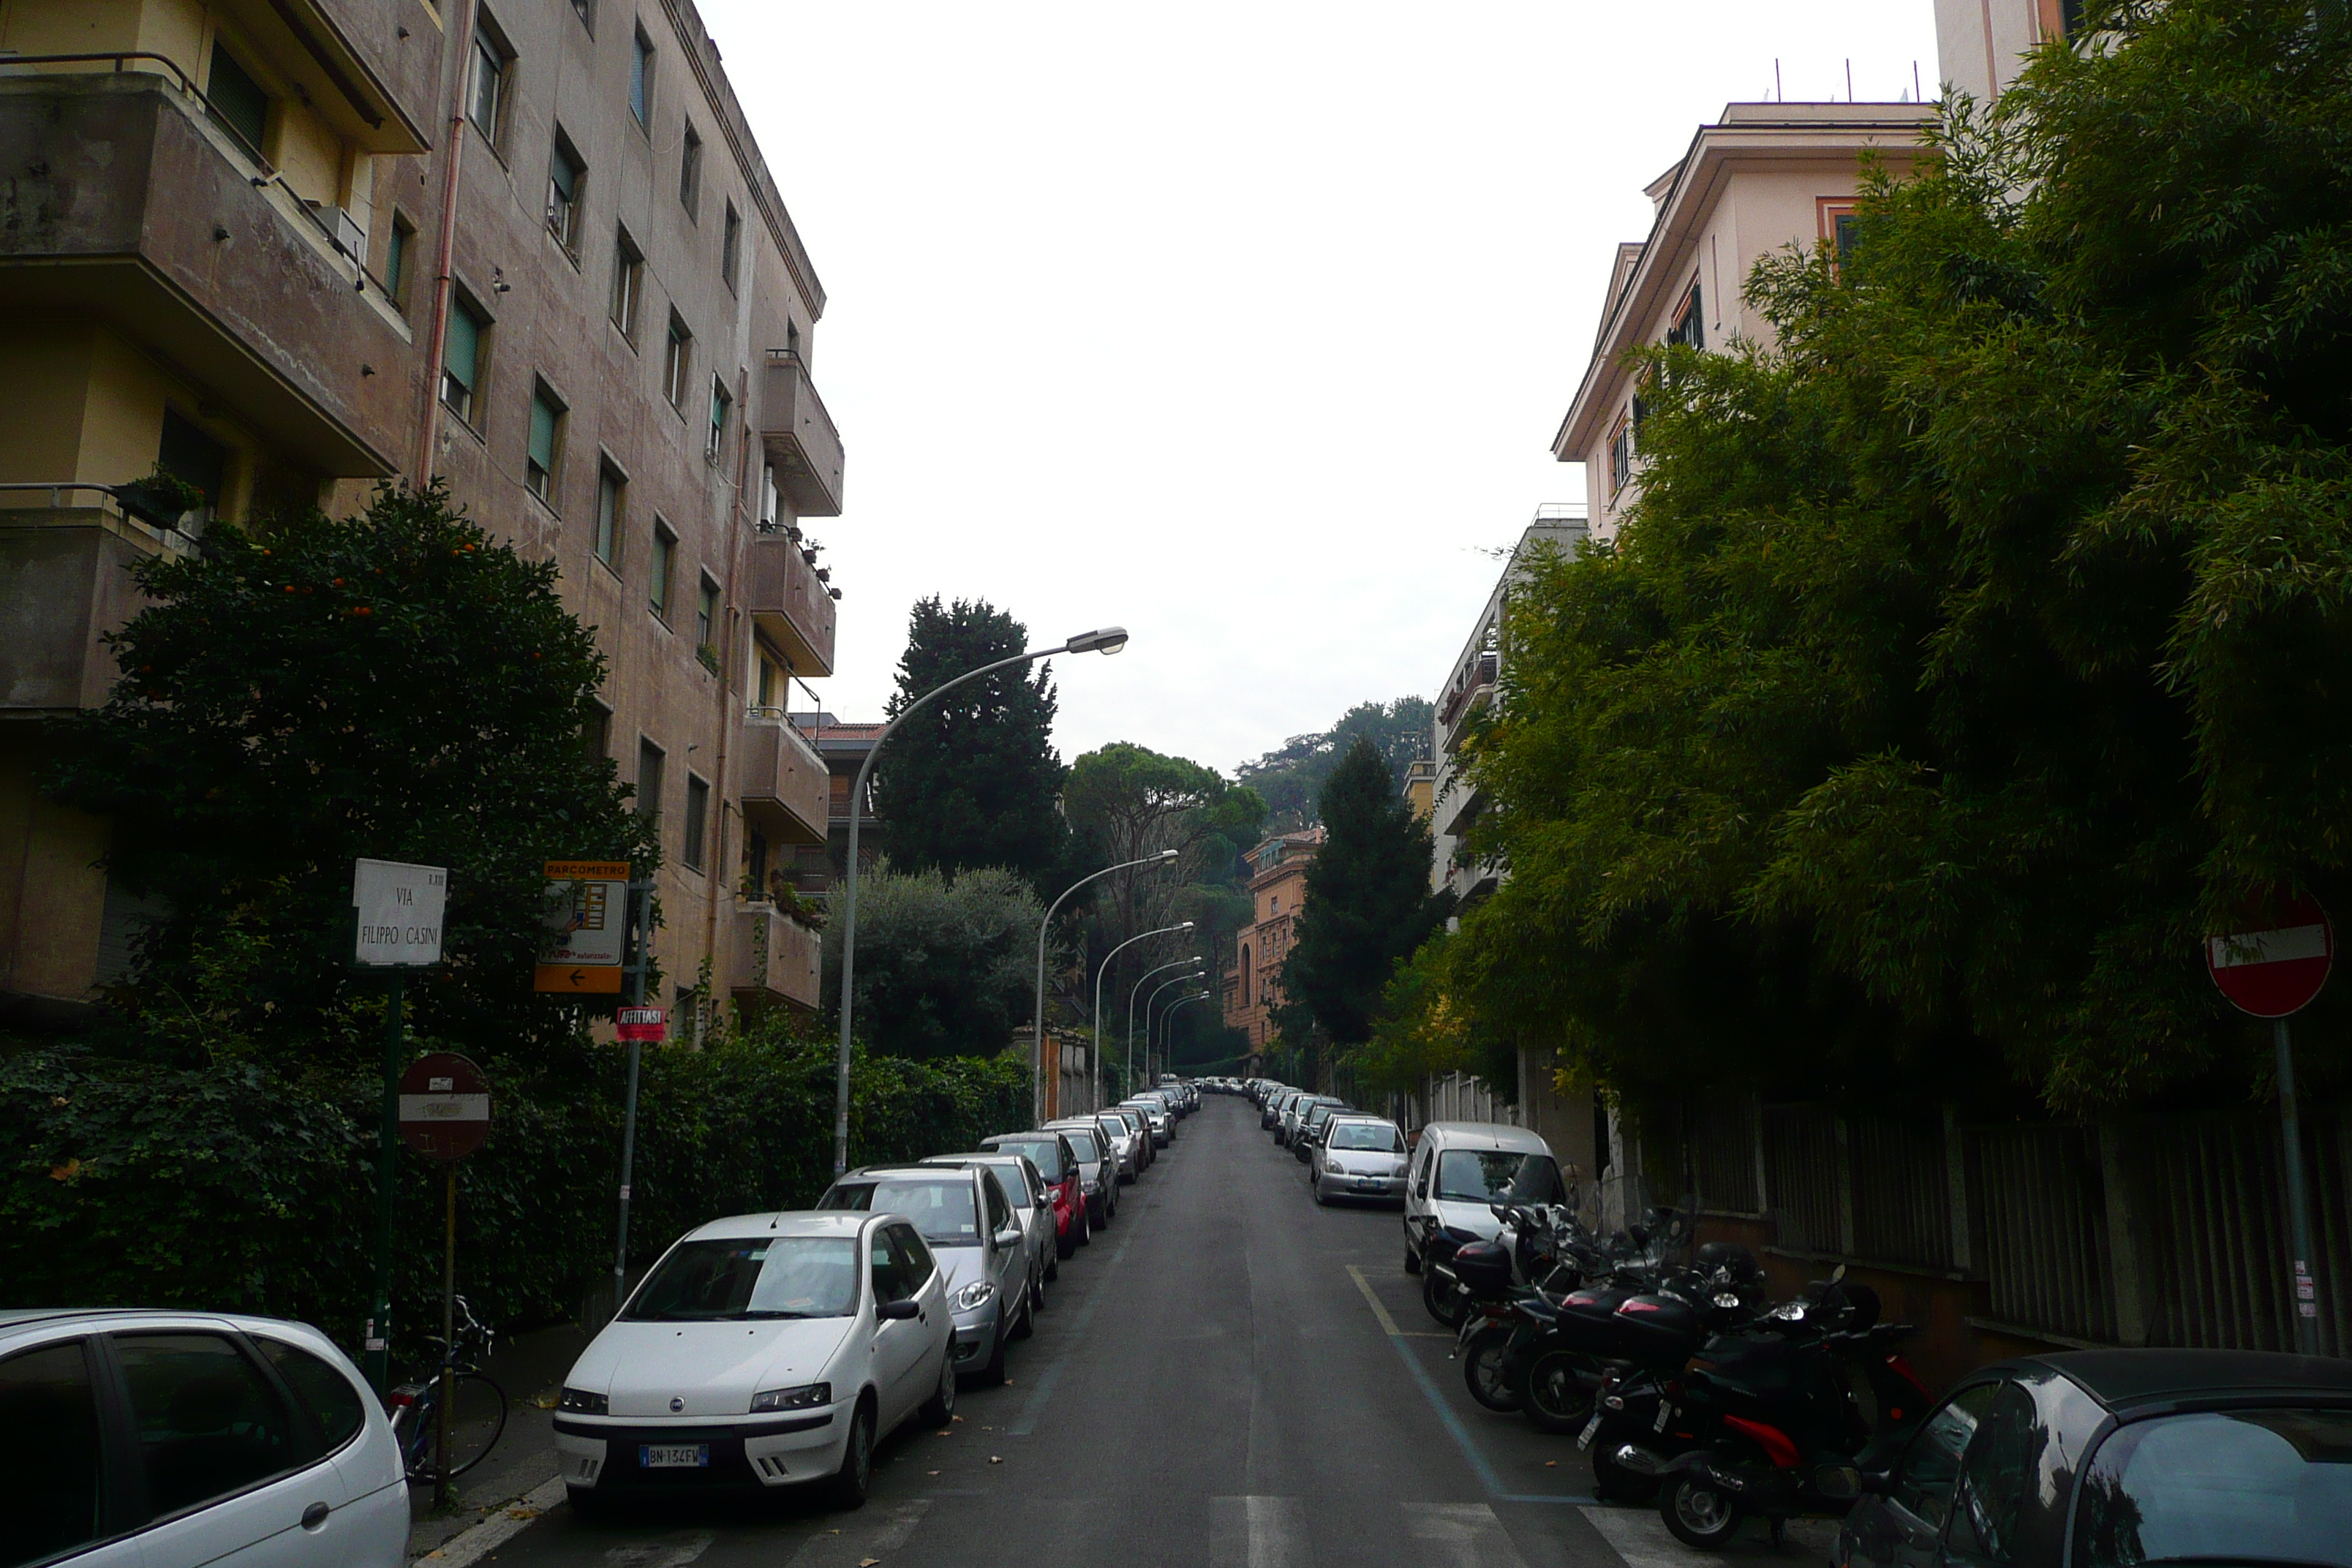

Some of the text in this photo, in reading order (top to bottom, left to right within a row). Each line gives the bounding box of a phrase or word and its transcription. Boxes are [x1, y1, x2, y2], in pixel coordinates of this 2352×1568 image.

[548, 865, 625, 875] PARCOMETRO
[396, 887, 412, 906] VIA
[362, 925, 438, 945] FILIPPO CASINI
[619, 1009, 662, 1025] AFFITTASI
